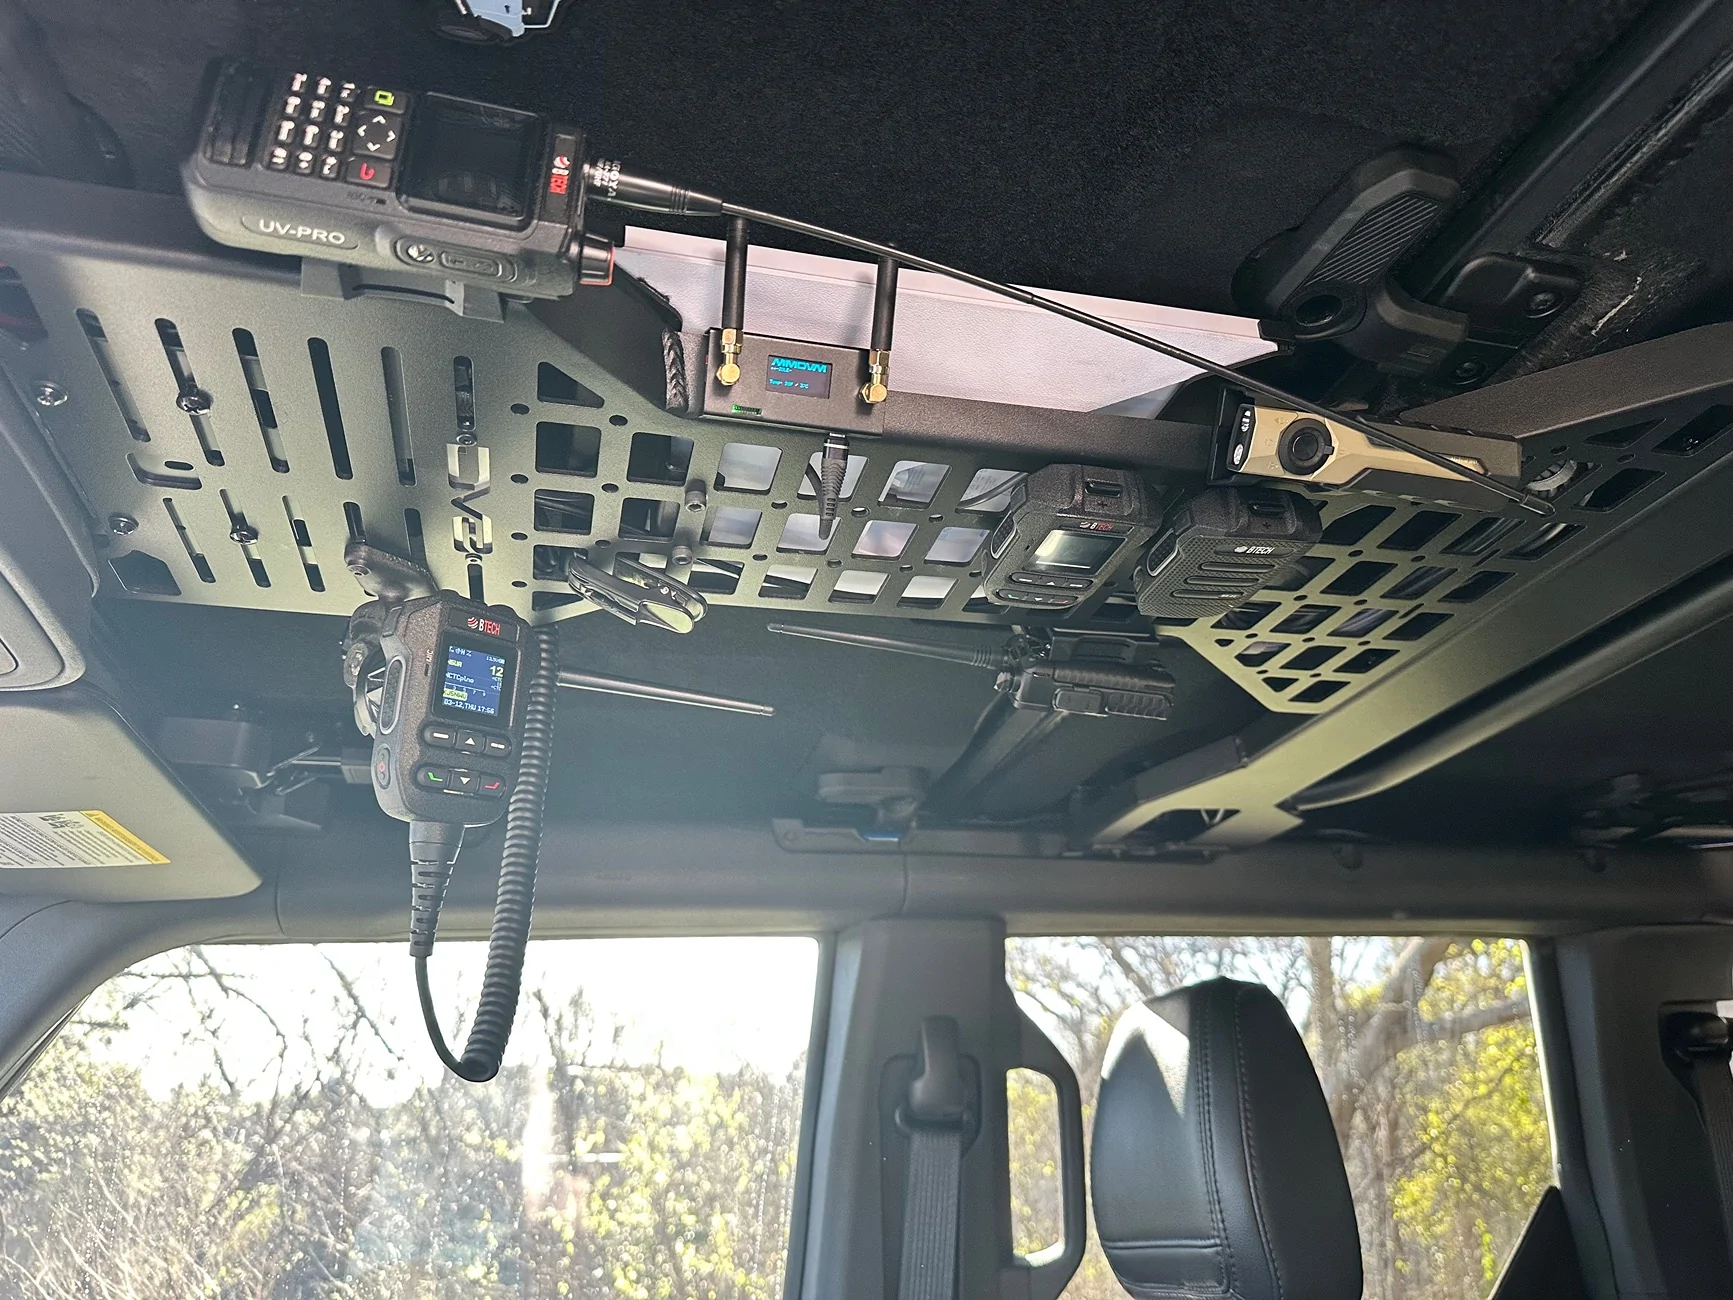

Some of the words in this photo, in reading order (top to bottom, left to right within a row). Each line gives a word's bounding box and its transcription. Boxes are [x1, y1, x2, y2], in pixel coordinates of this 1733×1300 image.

[258, 218, 346, 245] UV-PRO
[1090, 522, 1114, 531] BTECH
[1246, 545, 1275, 556] BTECH
[479, 618, 500, 635] BTECH
[490, 665, 504, 677] 12
